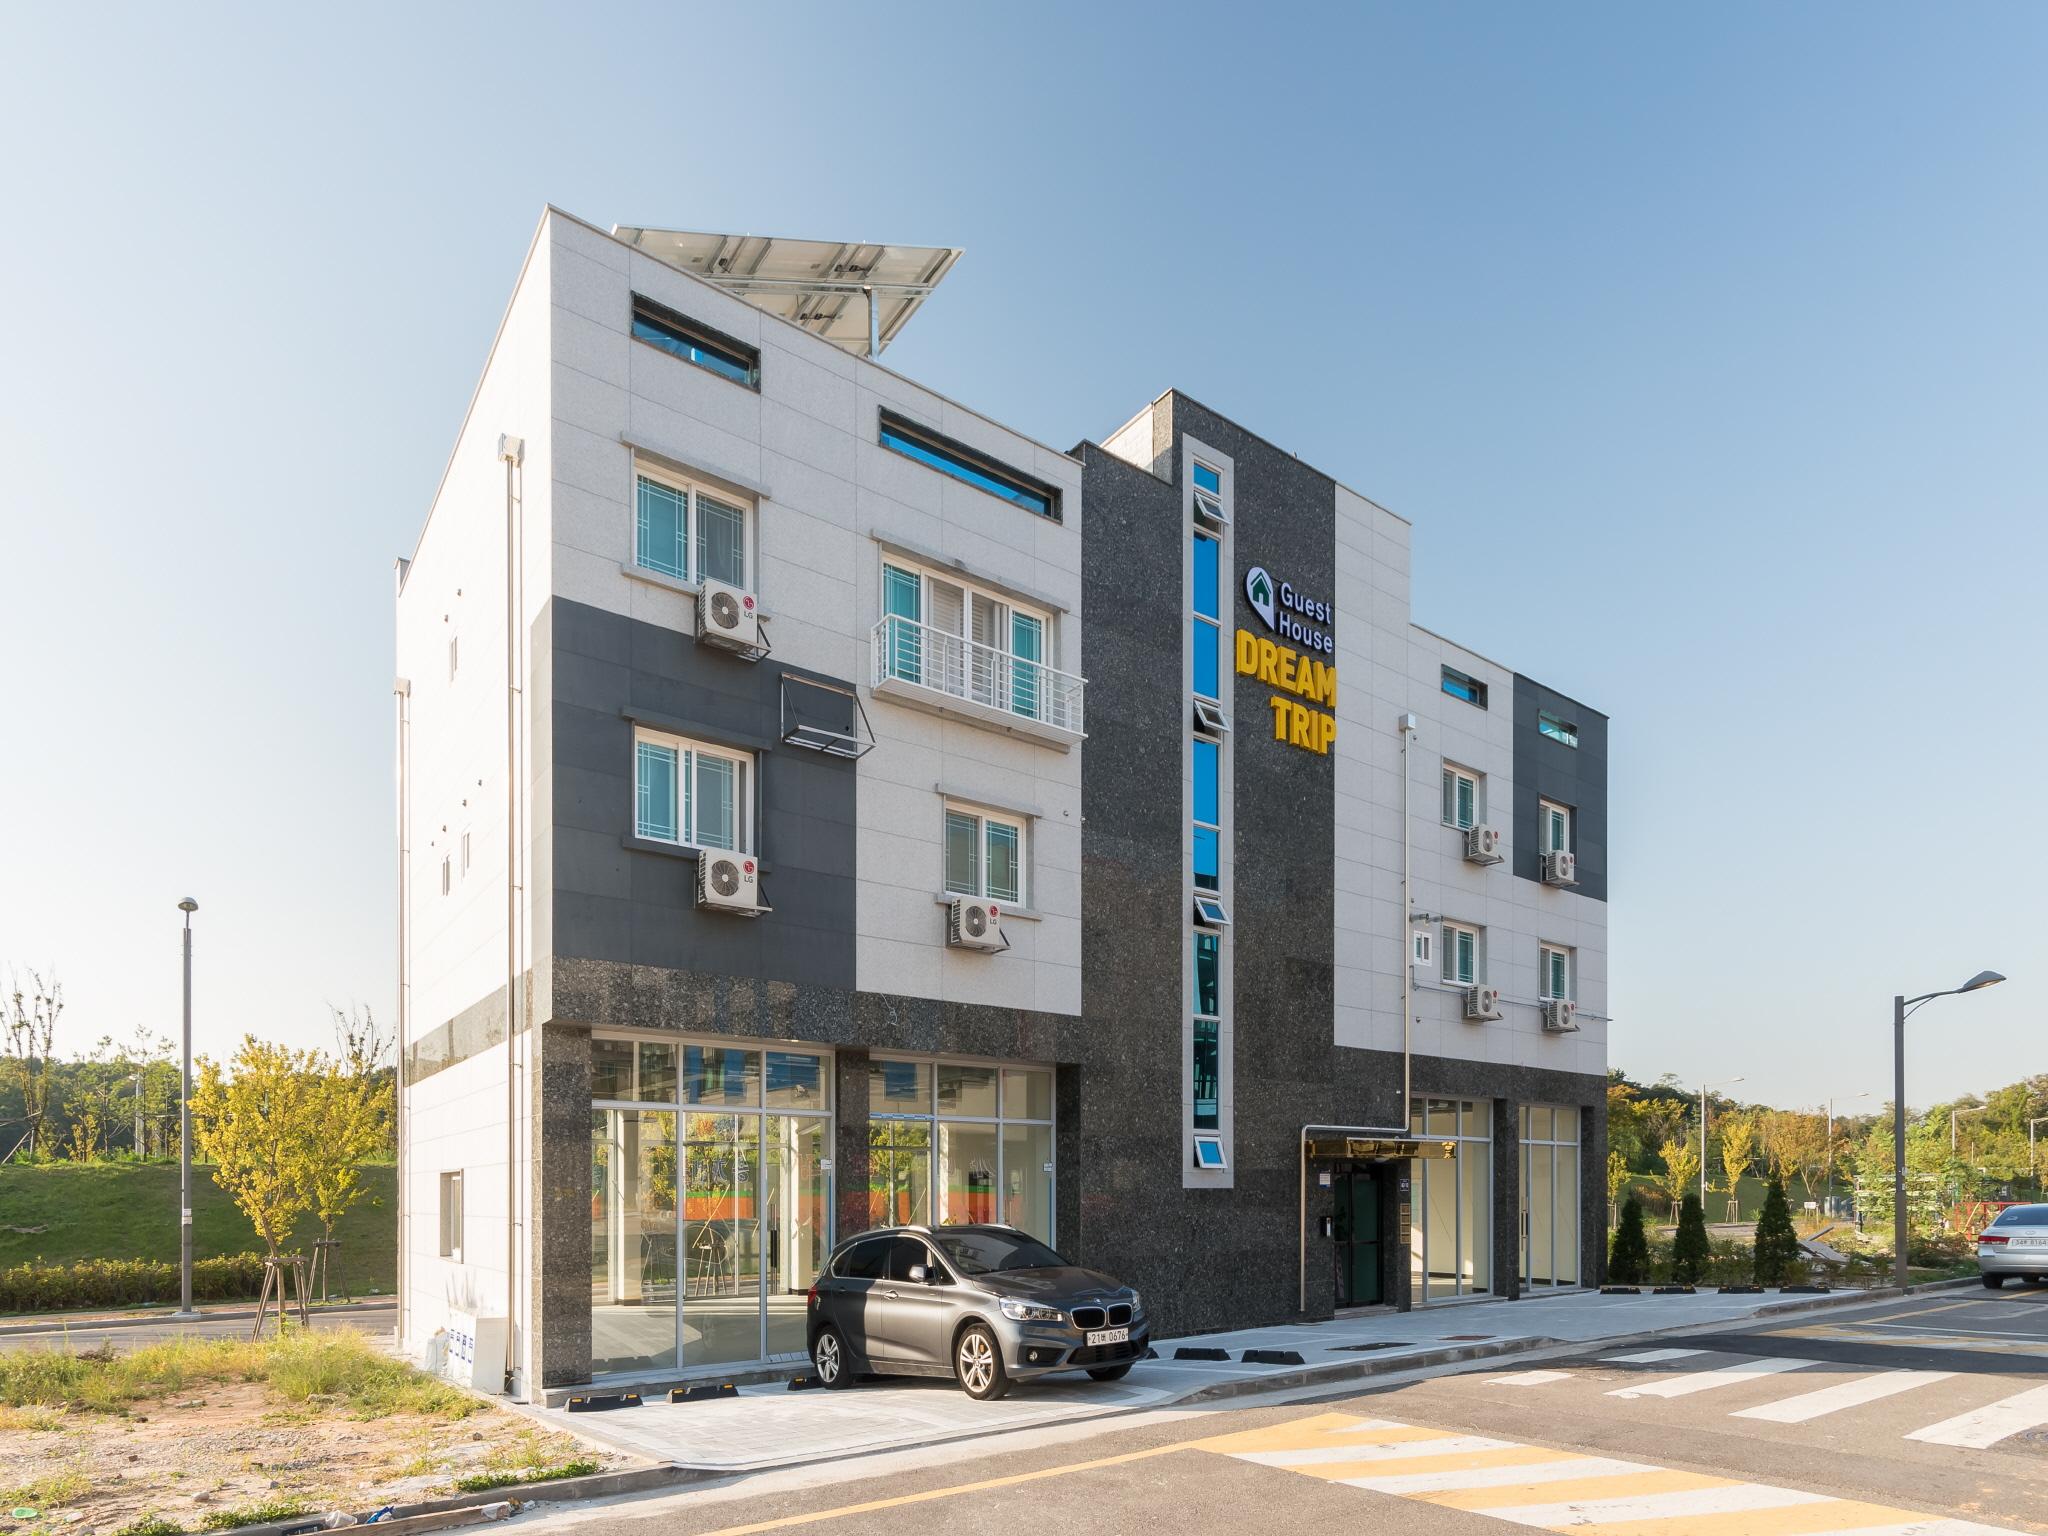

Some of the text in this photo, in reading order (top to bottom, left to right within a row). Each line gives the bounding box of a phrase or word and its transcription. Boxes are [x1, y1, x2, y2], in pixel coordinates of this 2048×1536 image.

[743, 611, 753, 619] LG
[1279, 582, 1331, 625] Guest
[1278, 610, 1333, 654] House
[1236, 629, 1337, 709] DREAM
[1270, 695, 1337, 755] TRIP
[744, 875, 754, 883] LG
[1108, 1330, 1126, 1342] 0676
